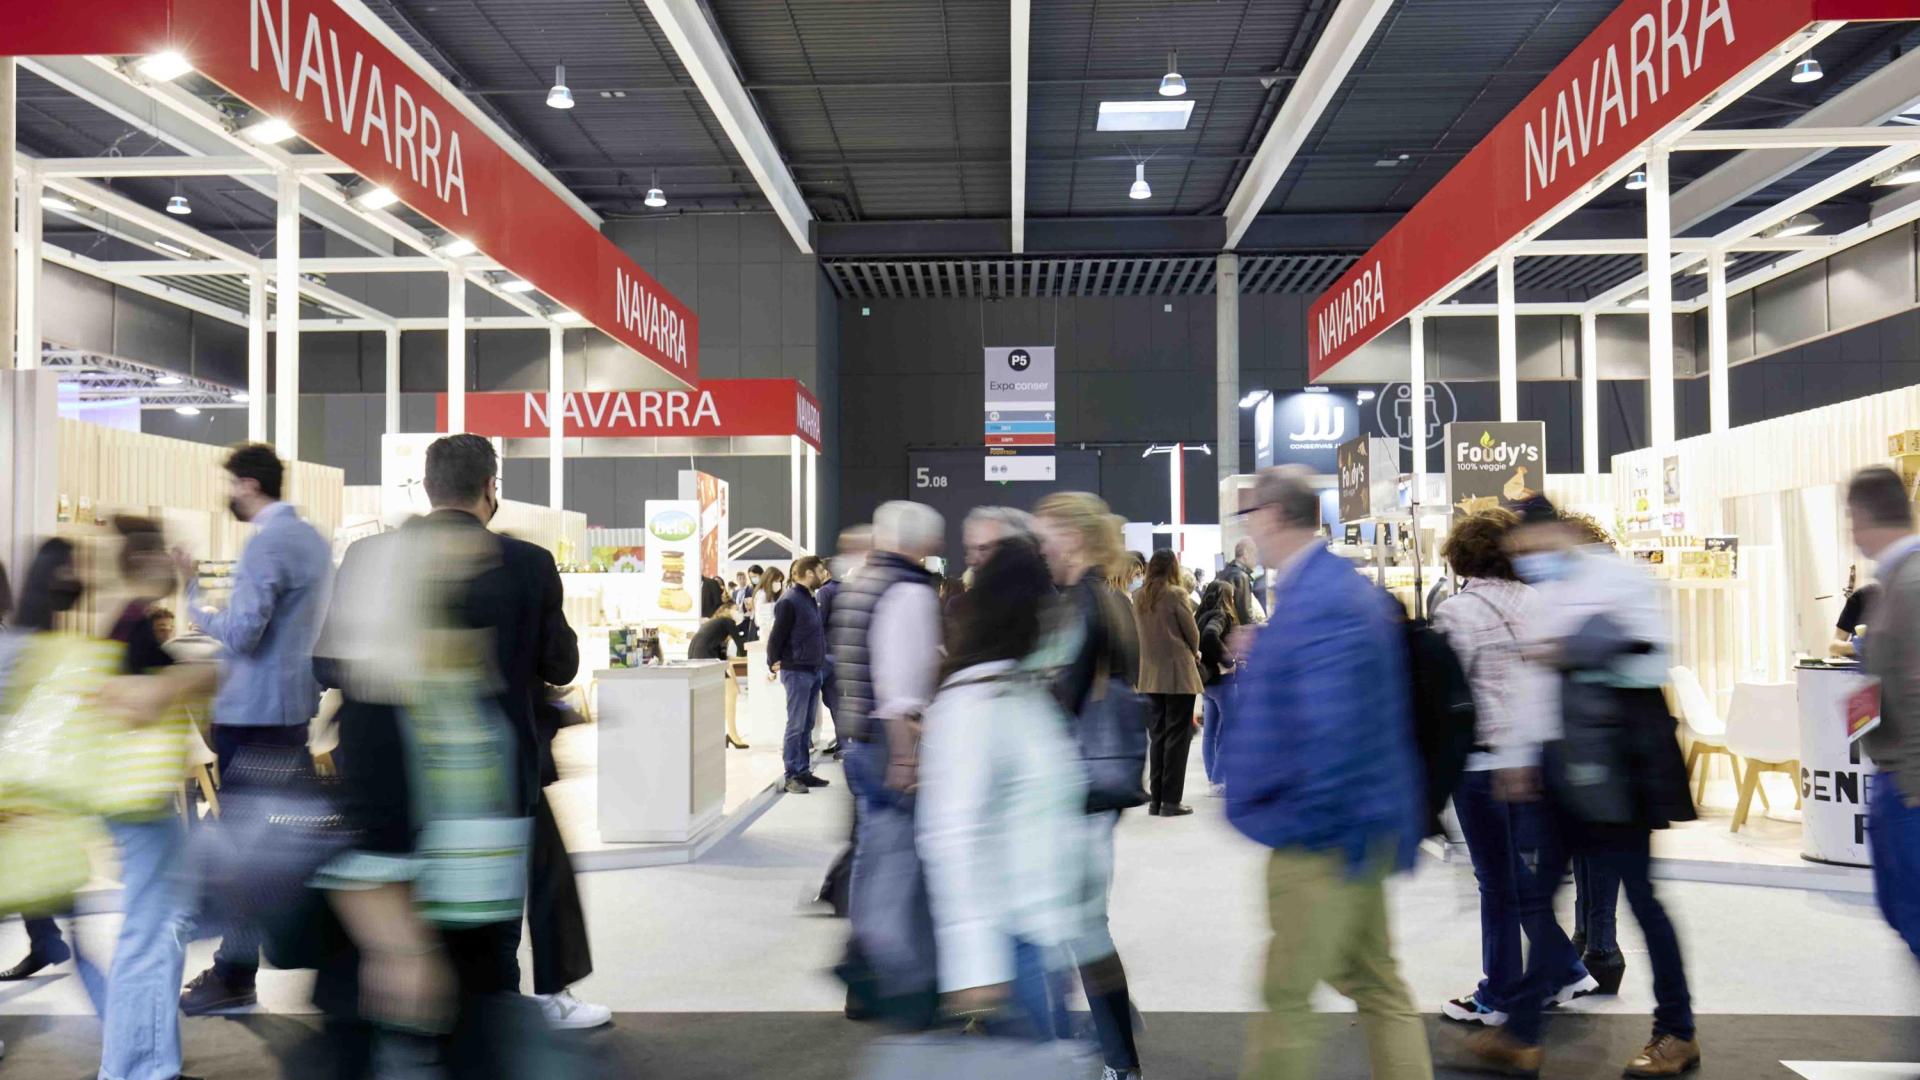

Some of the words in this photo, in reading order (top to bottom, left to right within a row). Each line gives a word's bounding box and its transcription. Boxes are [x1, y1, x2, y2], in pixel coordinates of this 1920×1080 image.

[250, 0, 468, 216] NAVARRA
[1524, 0, 1736, 202] NAVARRA
[616, 267, 688, 369] NAVARRA
[1318, 260, 1385, 361] NAVARRA
[1011, 355, 1028, 367] P5
[989, 380, 1049, 392] Expoconser
[523, 390, 721, 428] NAVARRA
[796, 391, 821, 444] NAVARRA
[1457, 441, 1539, 467] Foody's
[1457, 463, 1478, 471] 100%
[1479, 463, 1507, 472] veggie
[916, 467, 948, 488] 5.08
